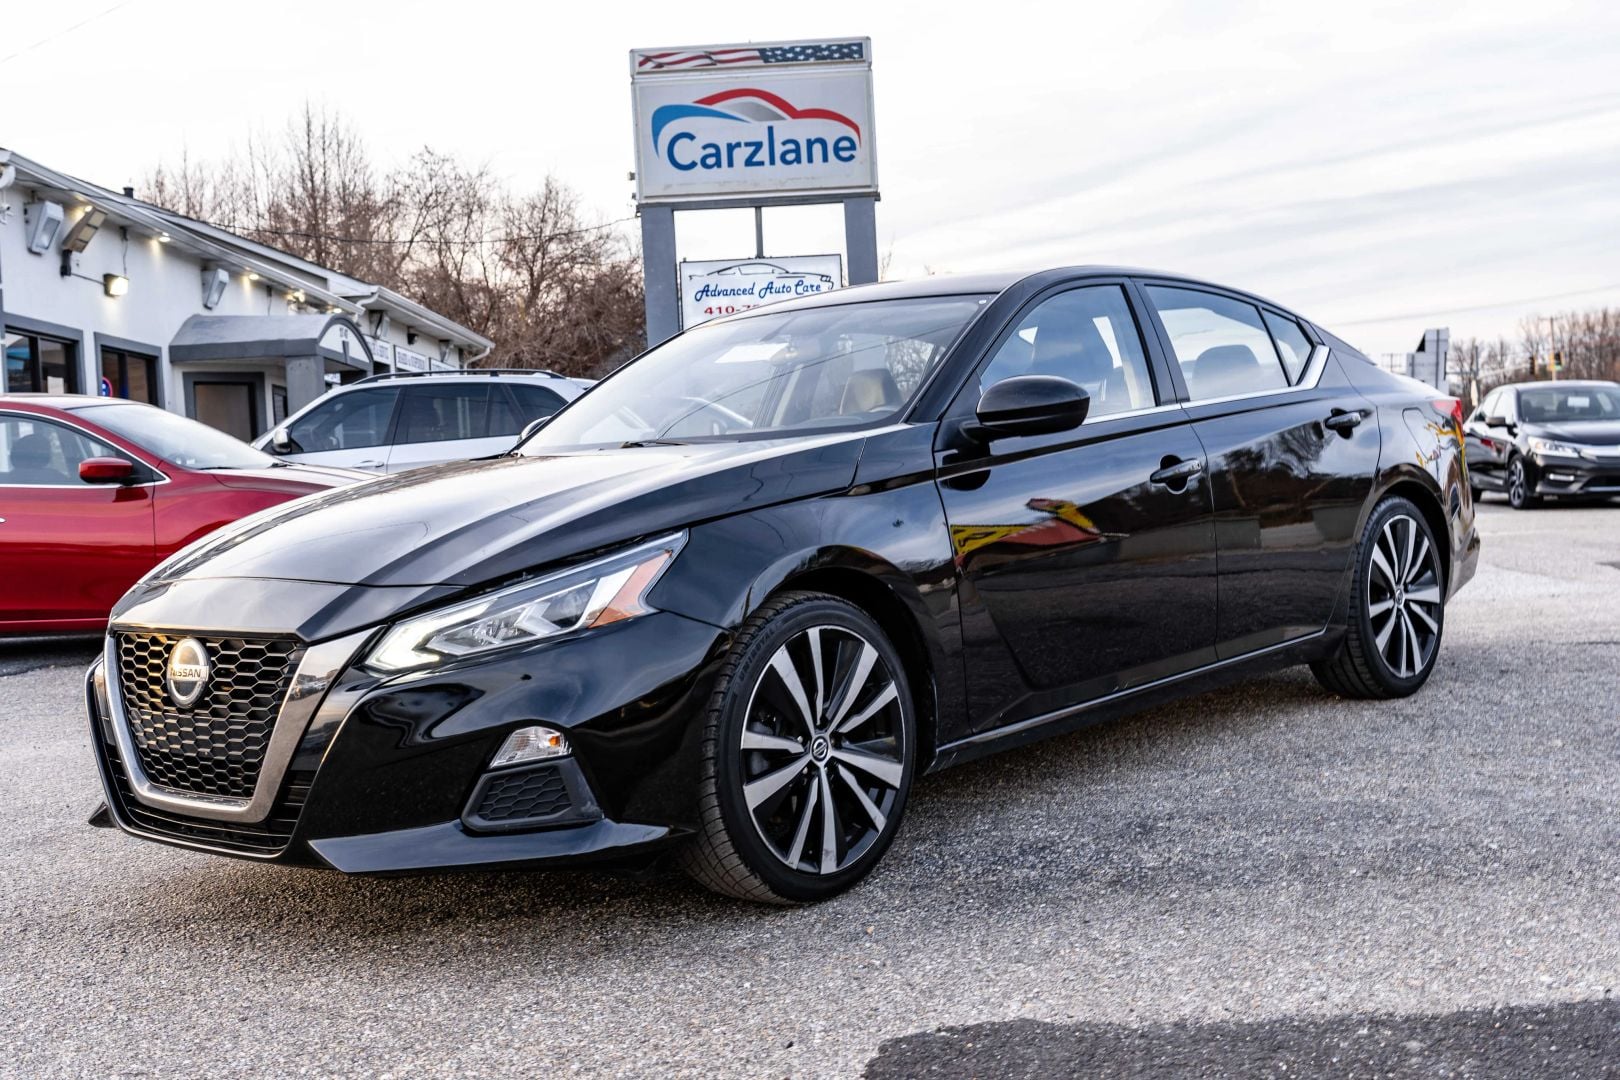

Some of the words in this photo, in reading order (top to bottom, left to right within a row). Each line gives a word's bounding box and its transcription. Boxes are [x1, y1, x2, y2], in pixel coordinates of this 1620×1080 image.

[667, 125, 857, 171] Carzlane
[695, 282, 755, 301] Advanced
[758, 281, 792, 299] Auto
[794, 279, 821, 296] Care
[704, 304, 759, 315] 410-
[170, 668, 202, 678] NISSAN
